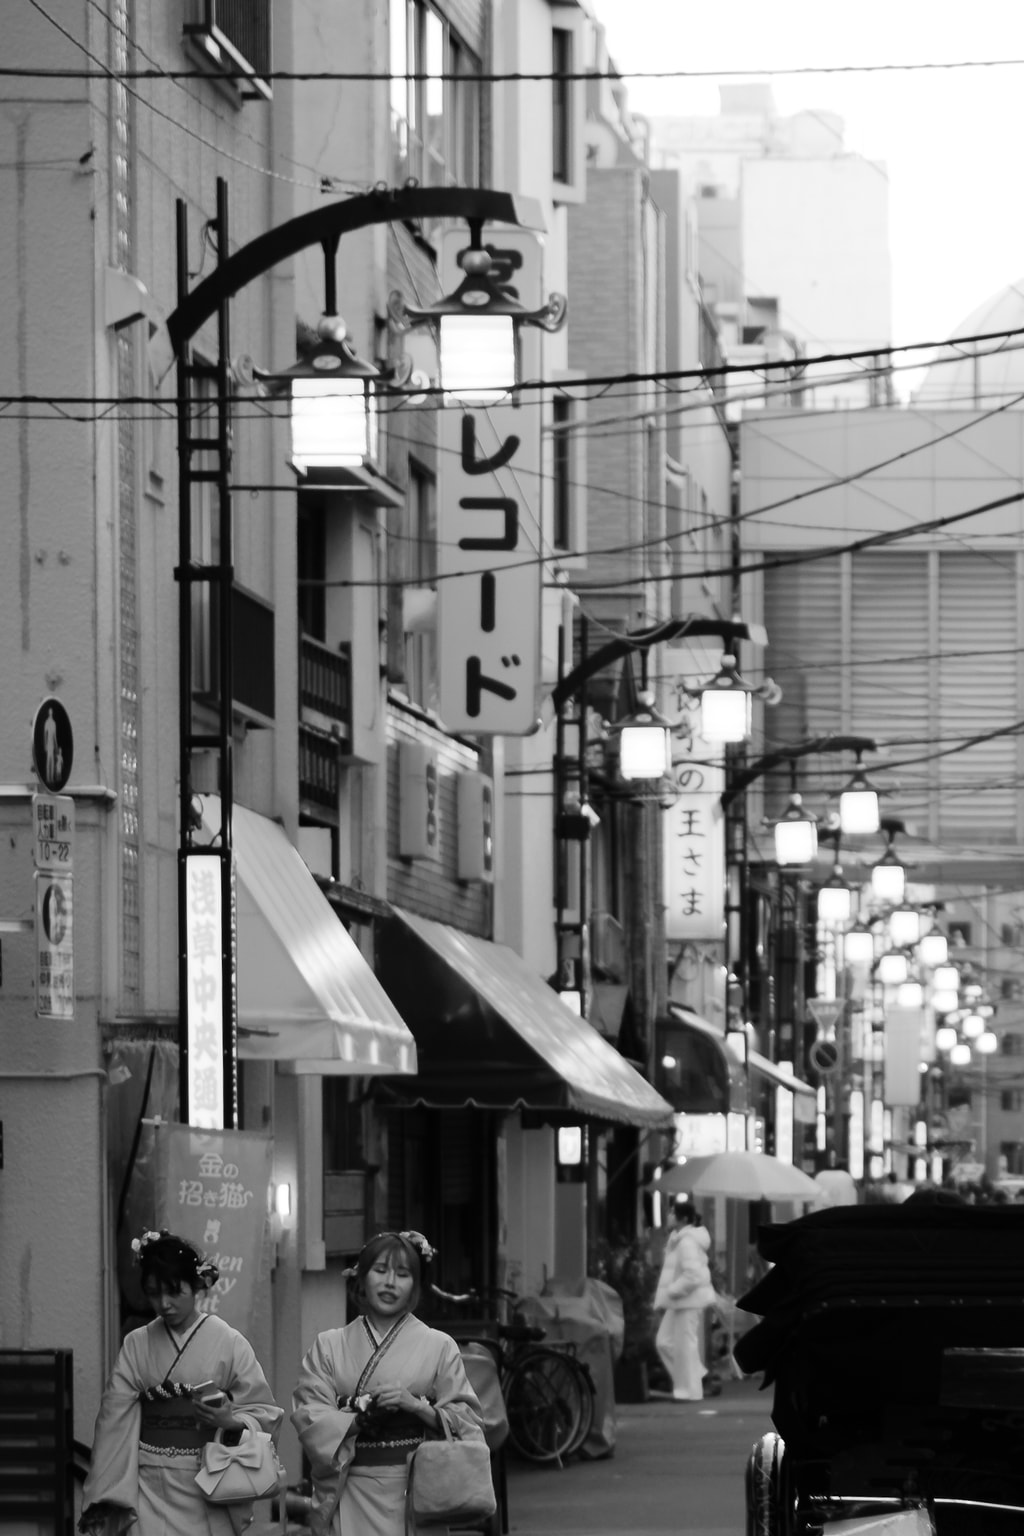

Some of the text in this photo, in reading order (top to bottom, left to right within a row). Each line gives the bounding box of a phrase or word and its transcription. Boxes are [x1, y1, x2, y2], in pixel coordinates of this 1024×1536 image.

[199, 1153, 239, 1179] 金の
[178, 1180, 253, 1209] 招き猫
